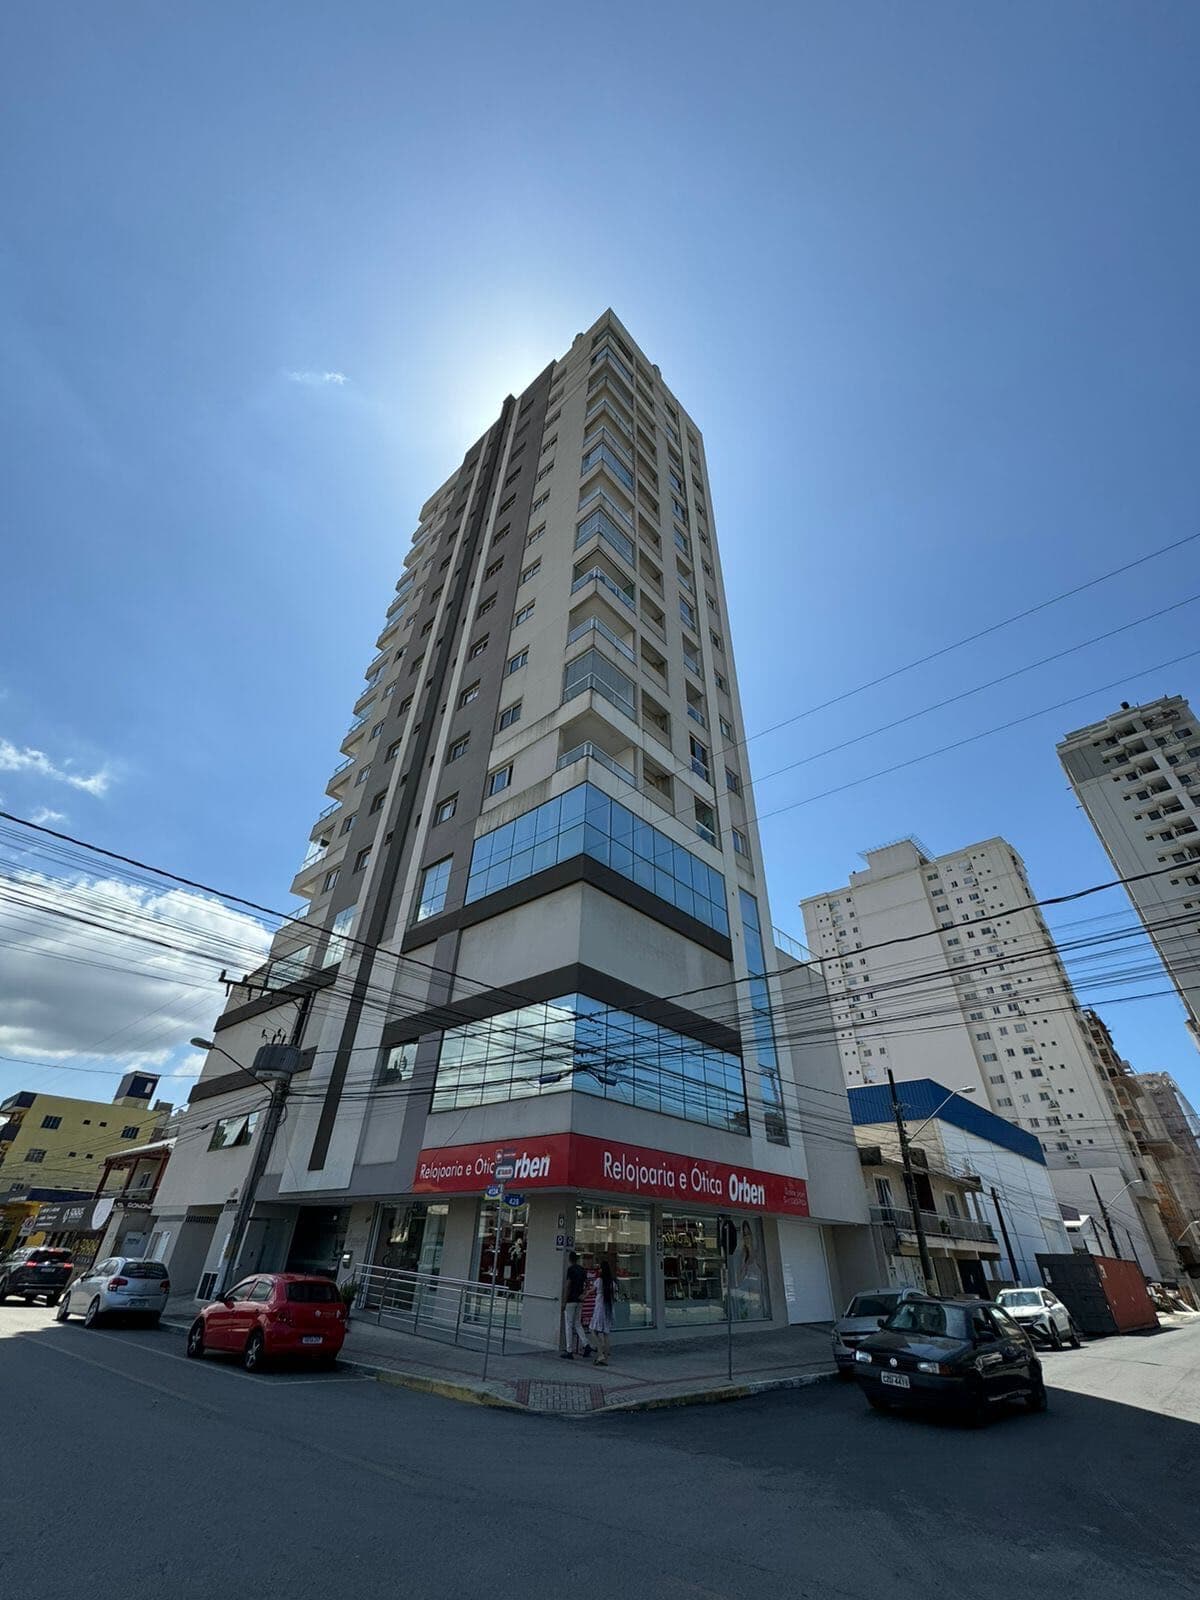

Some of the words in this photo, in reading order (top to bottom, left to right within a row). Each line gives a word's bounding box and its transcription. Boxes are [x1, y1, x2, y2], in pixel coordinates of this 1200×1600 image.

[420, 1160, 463, 1182] Relojoaria
[465, 1164, 471, 1176] e
[474, 1153, 496, 1176] Ótic
[513, 1152, 551, 1179] rben
[603, 1151, 675, 1189] Relojoaria
[679, 1173, 687, 1189] e
[690, 1162, 723, 1195] Ótica
[728, 1174, 766, 1206] Orben
